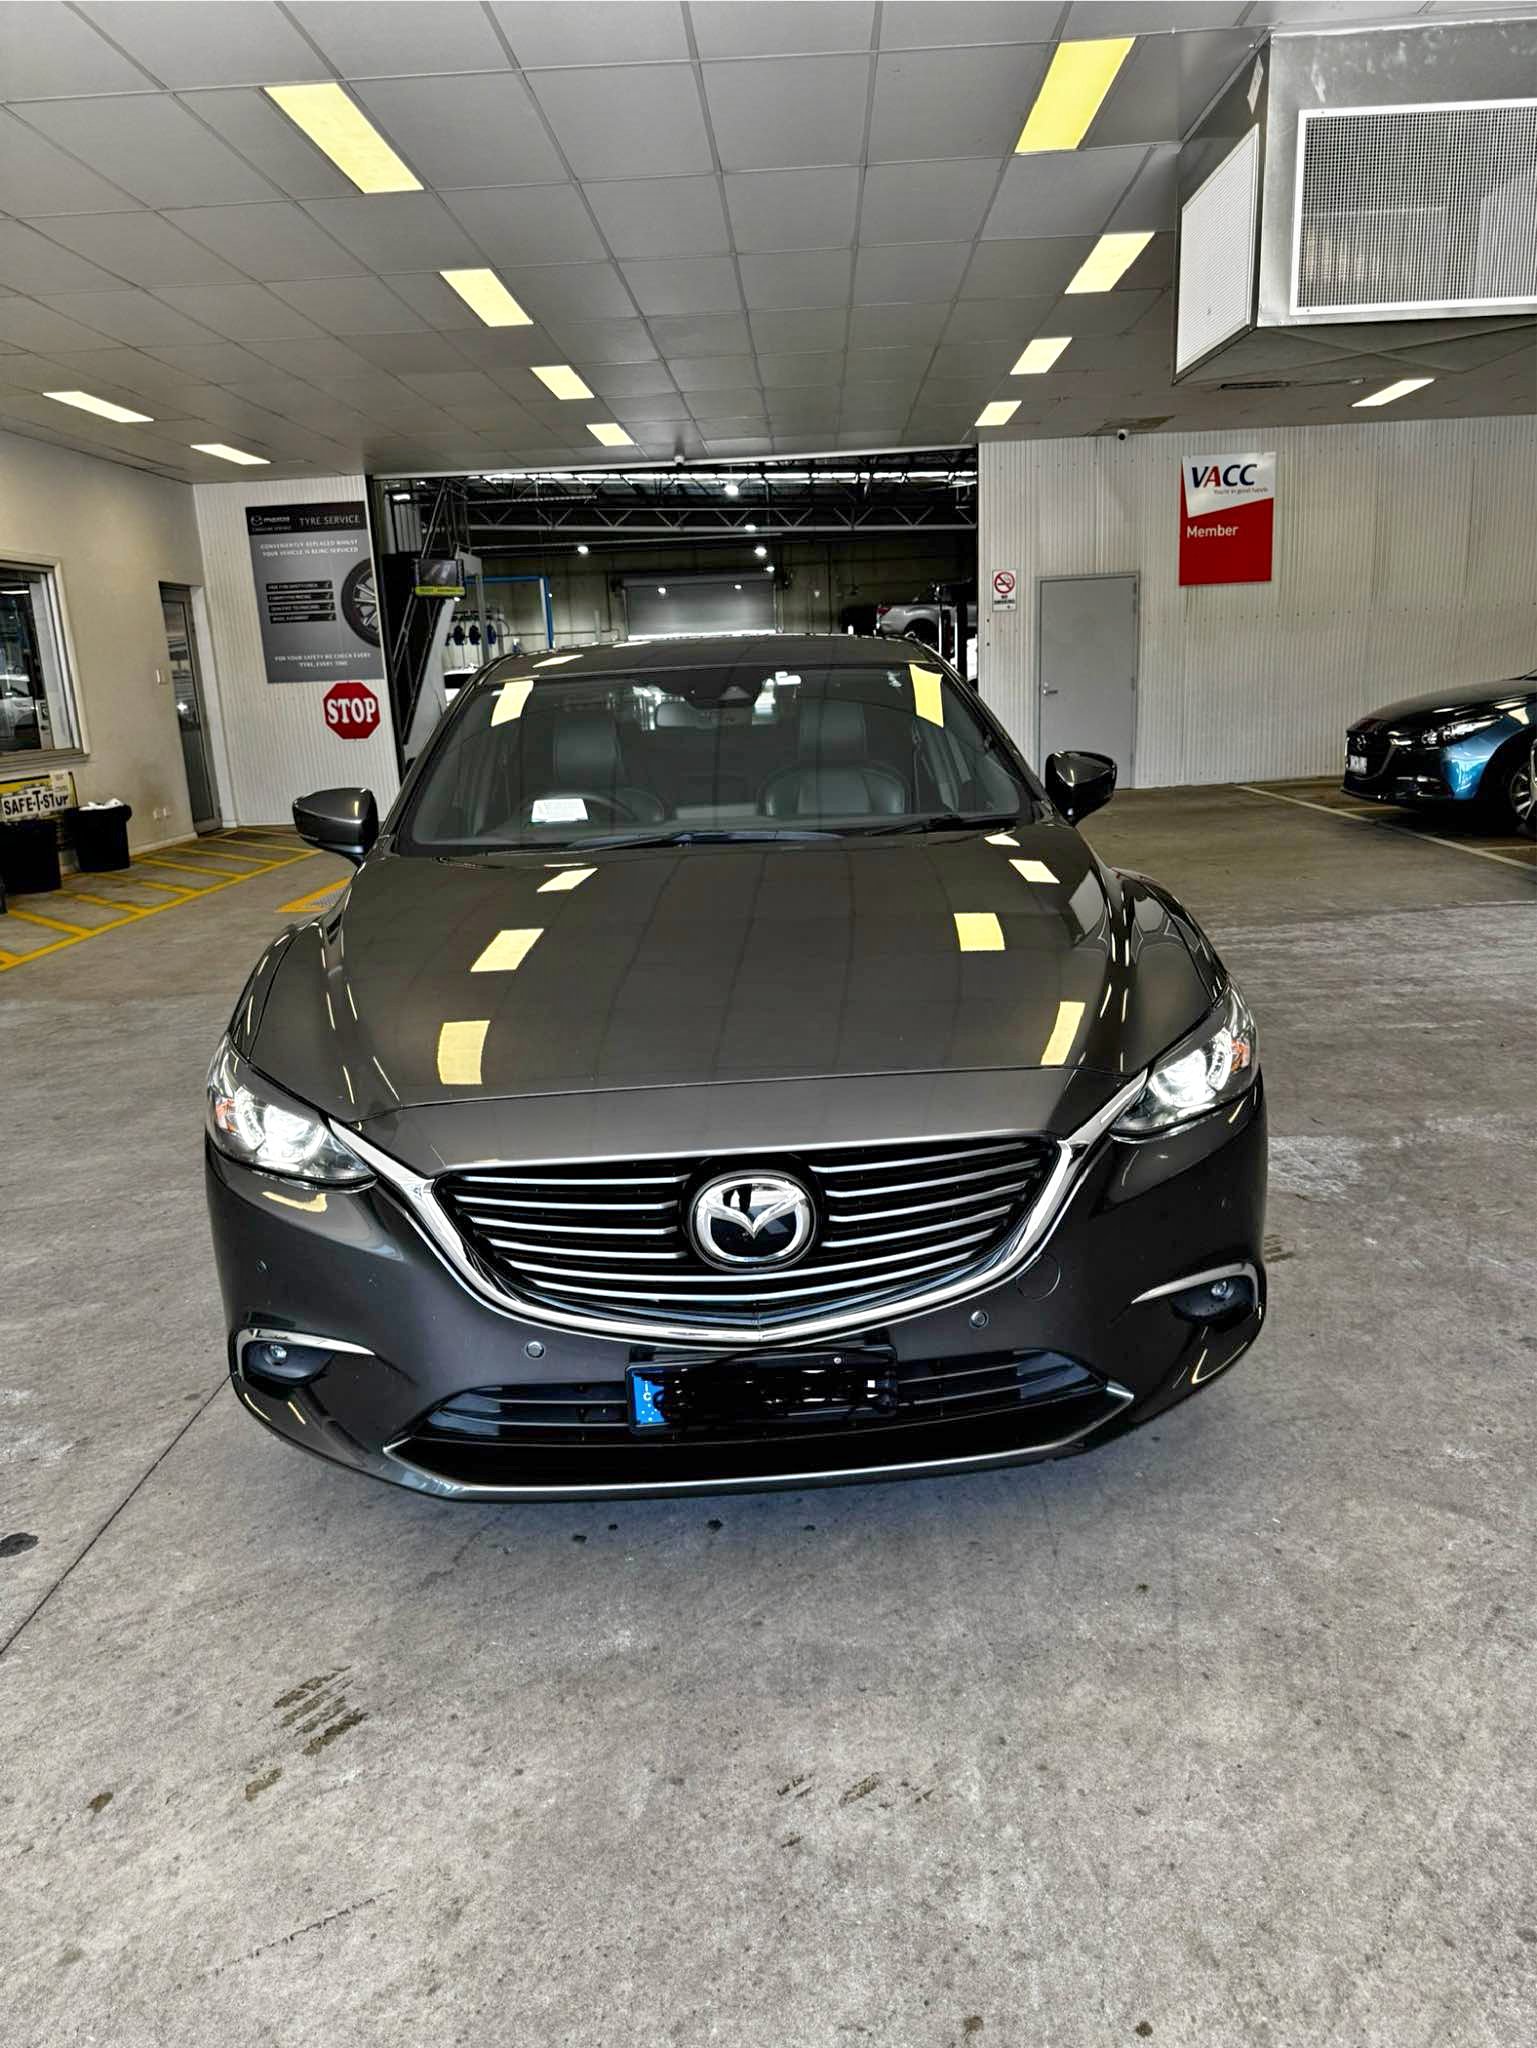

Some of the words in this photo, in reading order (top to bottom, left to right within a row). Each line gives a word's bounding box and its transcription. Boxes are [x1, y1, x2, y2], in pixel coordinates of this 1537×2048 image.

[1192, 464, 1257, 488] VACC
[299, 516, 320, 526] TYRE
[322, 514, 361, 525] SERVICE
[1187, 524, 1239, 539] Member
[327, 698, 376, 724] STOP
